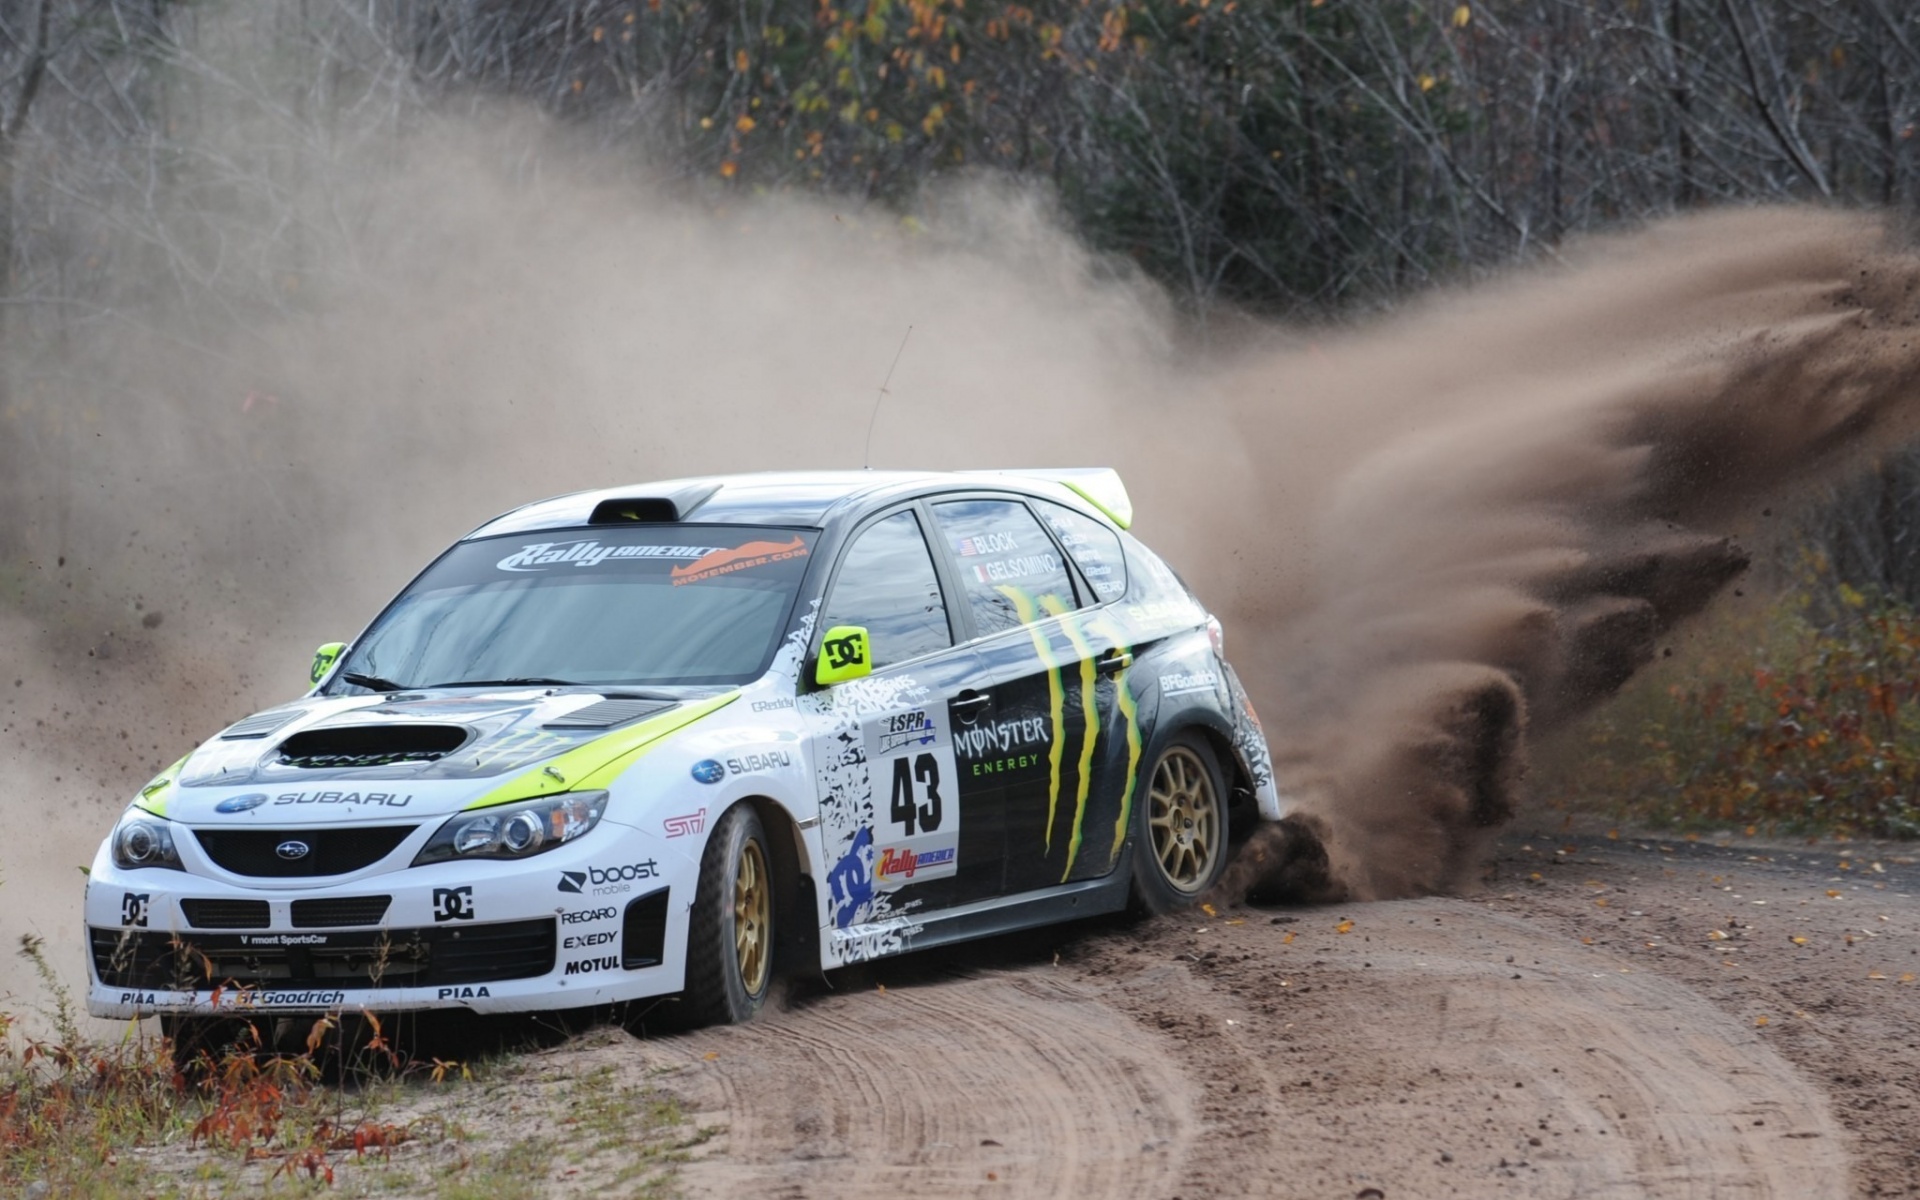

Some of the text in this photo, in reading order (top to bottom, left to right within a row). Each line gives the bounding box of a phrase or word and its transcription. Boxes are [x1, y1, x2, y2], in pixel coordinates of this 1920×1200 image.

[972, 531, 1019, 555] BLOCK
[503, 540, 605, 570] Rally
[985, 553, 1056, 580] GELSOMINO
[672, 548, 808, 587] MOVEMBER.COM
[751, 697, 794, 712] GReddy
[889, 710, 926, 733] LSPR
[953, 716, 1050, 759] MONSTER
[726, 750, 791, 775] SUBARU
[972, 753, 1038, 776] ENERGY
[273, 791, 413, 808] SUBARU
[891, 752, 942, 837] 43
[588, 857, 660, 885] boost
[877, 847, 955, 880] Rally AMERICA
[593, 883, 631, 896] mobile
[561, 906, 618, 925] RECARO
[280, 934, 328, 946] SportsCar
[563, 930, 618, 949] EXEDY
[564, 955, 620, 975] MOTUL
[120, 993, 155, 1005] PIAA
[438, 986, 491, 1000] PIAA
